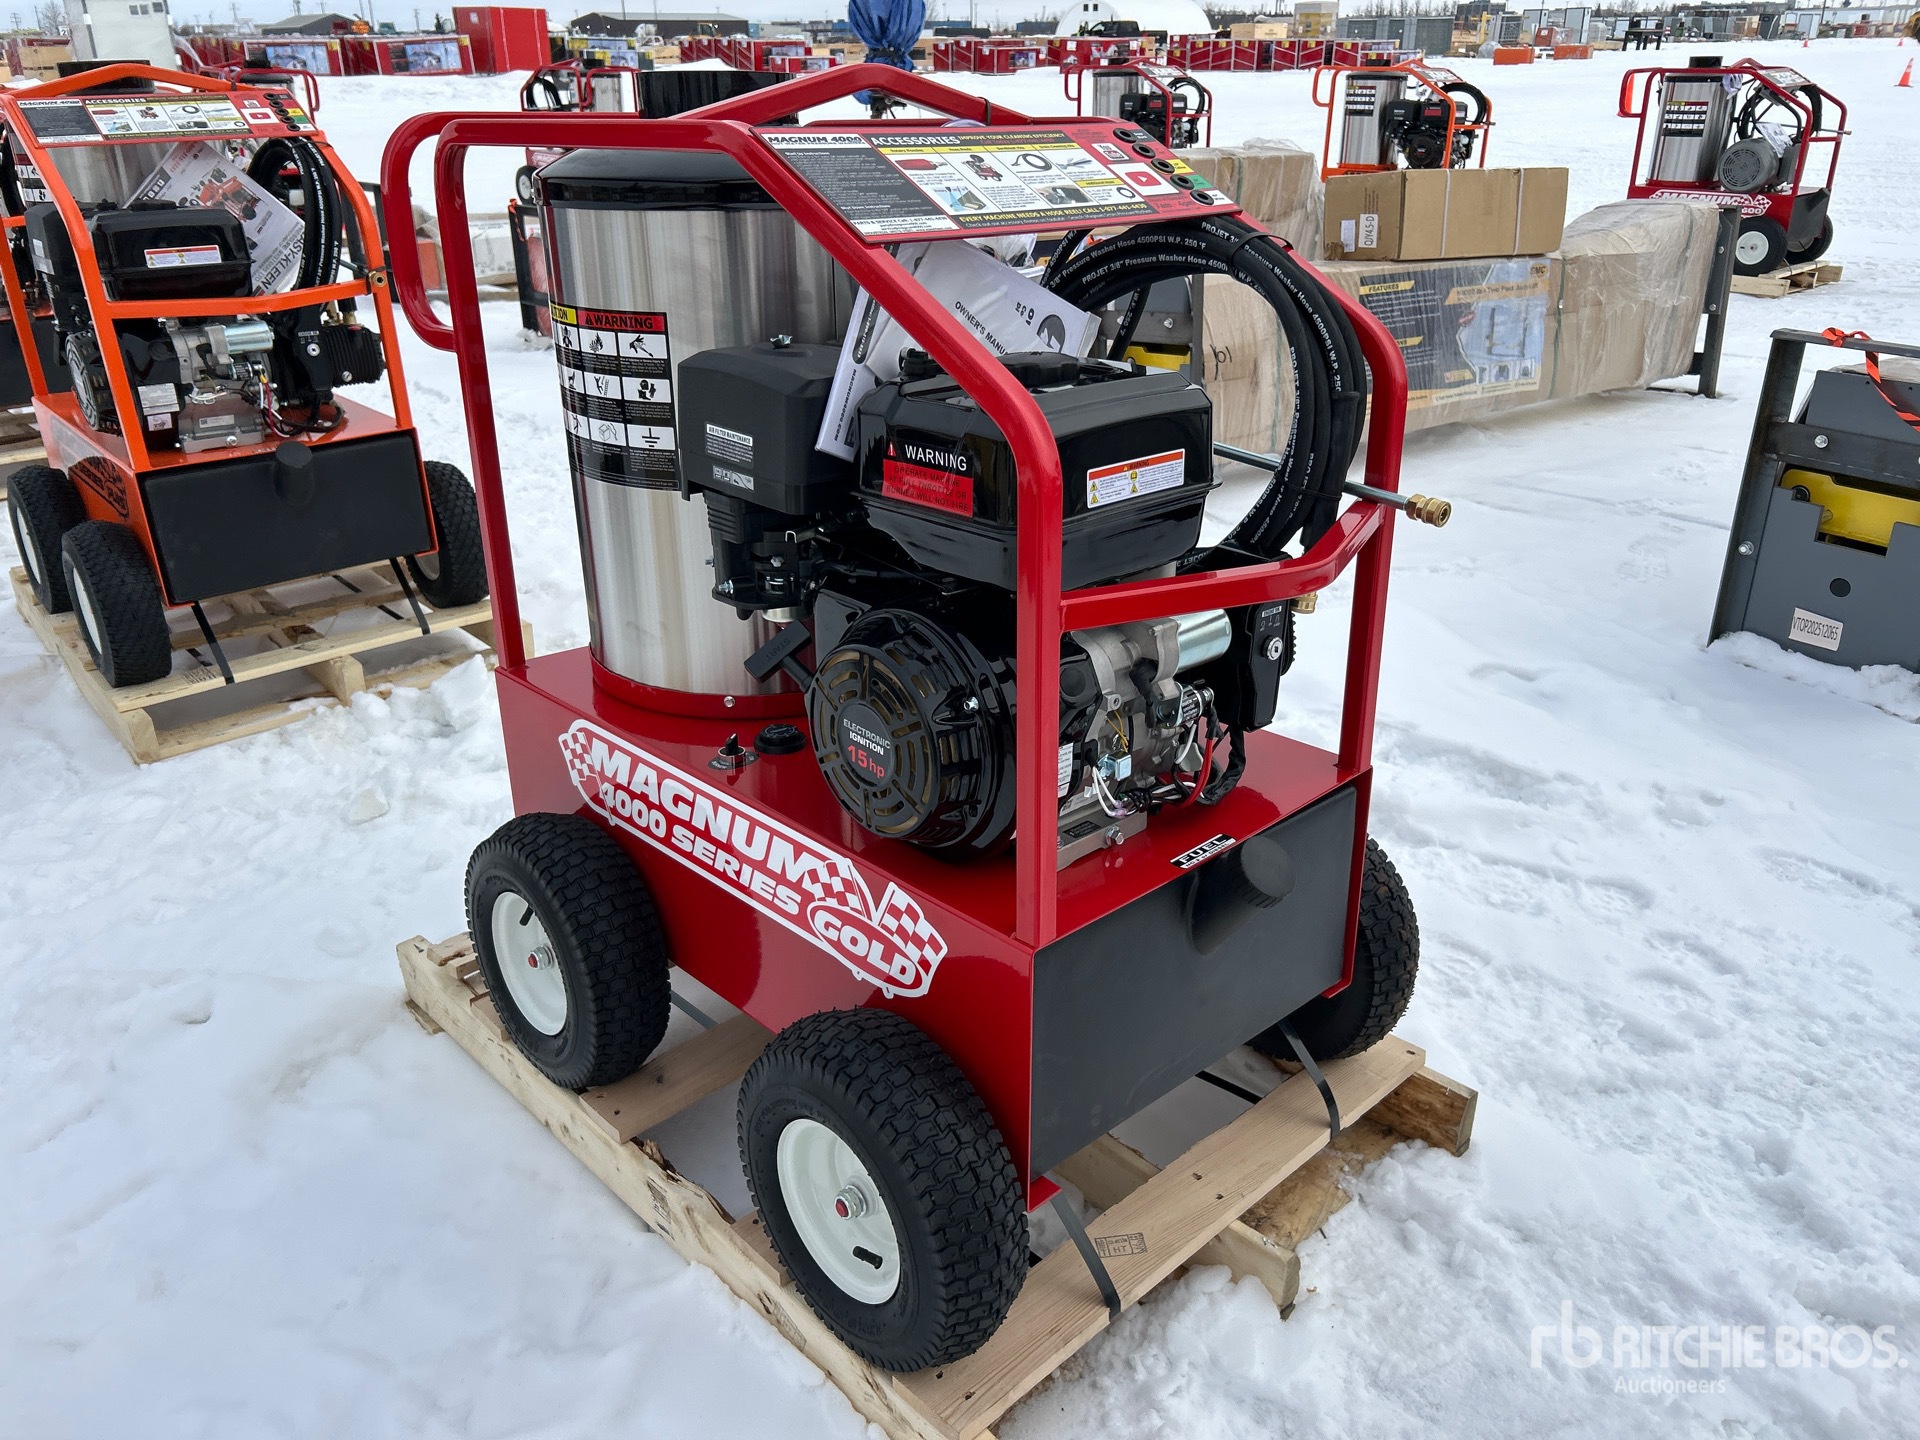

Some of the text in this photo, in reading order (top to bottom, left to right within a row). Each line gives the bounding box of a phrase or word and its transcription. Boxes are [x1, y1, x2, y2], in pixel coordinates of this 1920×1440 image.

[870, 136, 960, 146] ACCESSORIES
[983, 213, 1017, 221] MACHINE
[1062, 255, 1091, 279] Pressure
[1089, 244, 1117, 260] Washer
[1116, 238, 1136, 249] Hose
[1137, 235, 1166, 245] 4500PSI
[1184, 237, 1198, 247] 250
[1082, 265, 1109, 285] PROJET
[1110, 261, 1124, 274] 3/8"
[1124, 254, 1157, 267] Pressure
[1158, 253, 1187, 263] Washer
[1187, 255, 1208, 265] Hose
[1201, 221, 1230, 243] PROJET
[1243, 244, 1273, 270] Pressure
[1273, 266, 1299, 294] Washer
[1297, 290, 1313, 314] Hose
[1312, 313, 1333, 350] 4500PSI
[1368, 283, 1400, 293] FEATURES
[593, 313, 654, 330] WARNING
[954, 300, 986, 336] OWNER'S
[904, 443, 967, 471] WARNING
[930, 473, 961, 487] MACHINE
[886, 485, 969, 512] BURNER WILL NOT FIRE
[955, 489, 967, 500] OR
[1792, 616, 1839, 641] VTOP202512065
[843, 718, 891, 749] ELECTRONIC
[849, 731, 884, 756] IGNITION
[590, 736, 826, 885] MAGNUM
[599, 782, 803, 916] 4000 SERIES
[1178, 839, 1227, 863] FUEL
[813, 909, 917, 985] GOLD
